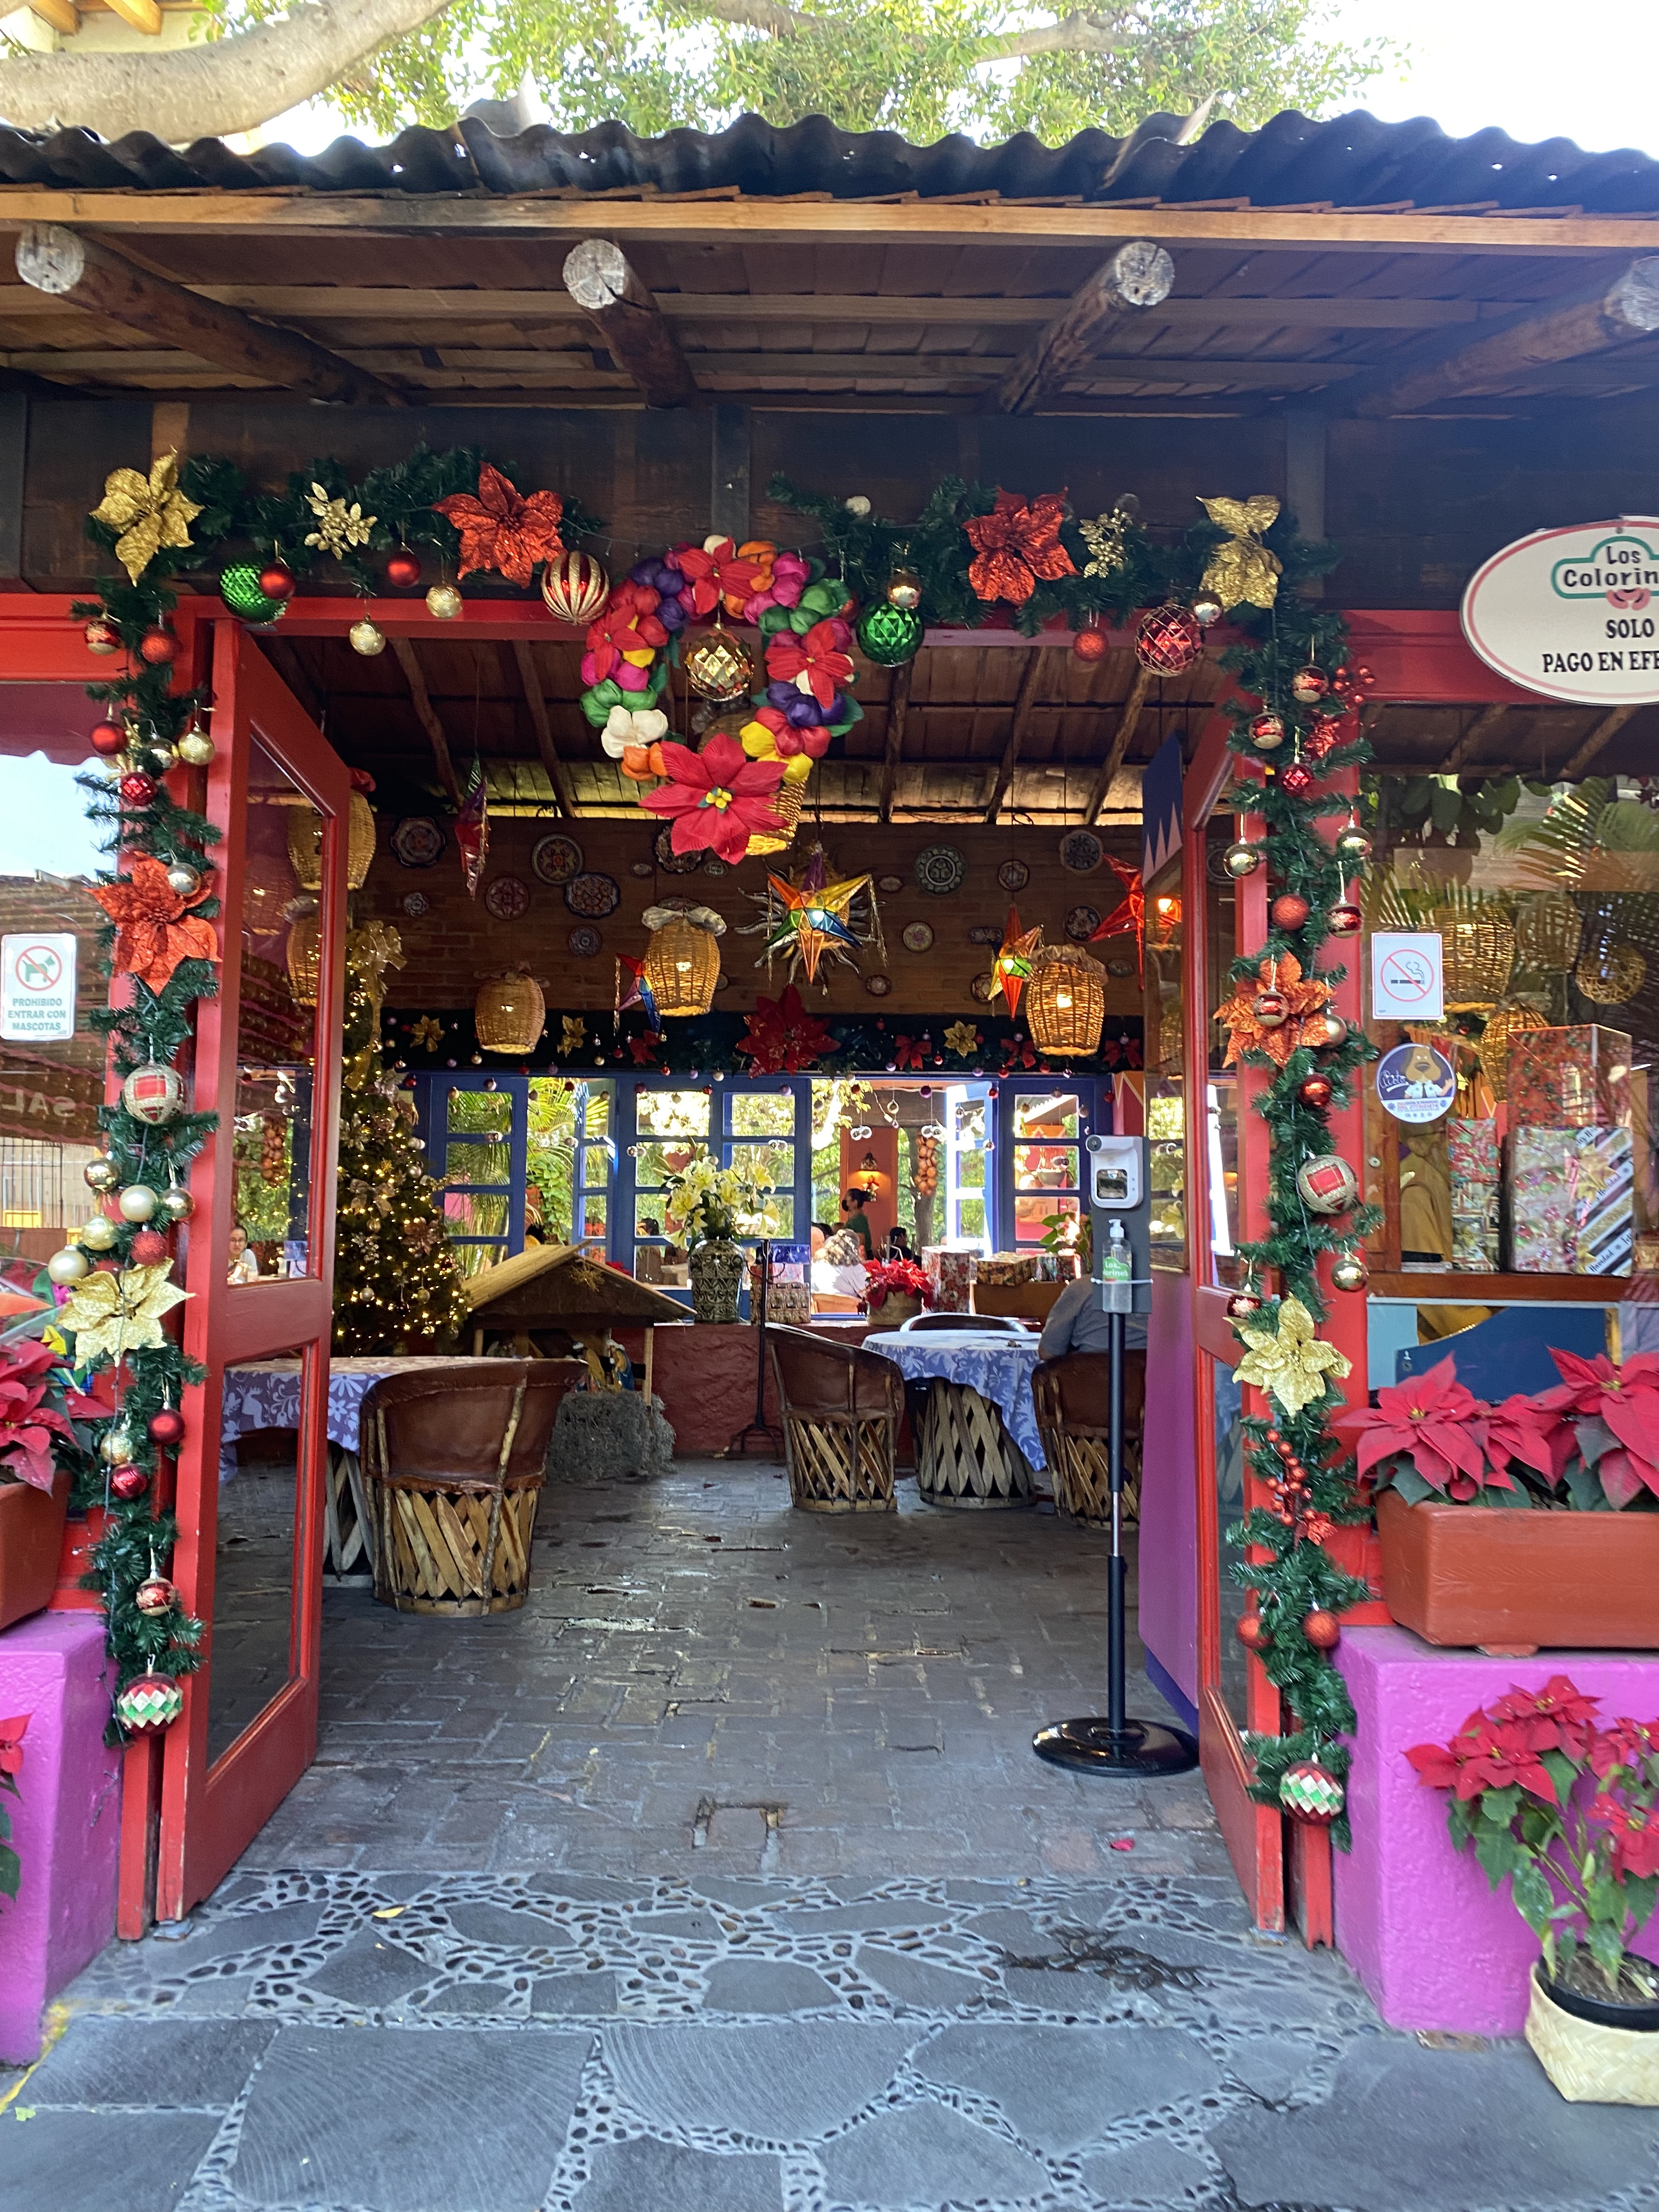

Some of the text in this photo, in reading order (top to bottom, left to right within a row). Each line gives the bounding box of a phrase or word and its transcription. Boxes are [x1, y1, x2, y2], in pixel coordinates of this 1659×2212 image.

[1607, 546, 1641, 565] Los
[1564, 568, 1658, 588] Colorin
[1606, 618, 1655, 639] SOLO
[1542, 652, 1593, 673] PAGO
[1599, 651, 1623, 671] EN
[12, 998, 63, 1006] PROHIBIDO
[8, 1010, 66, 1019] ENTRAR CON
[12, 1022, 61, 1031] MASCOTAS
